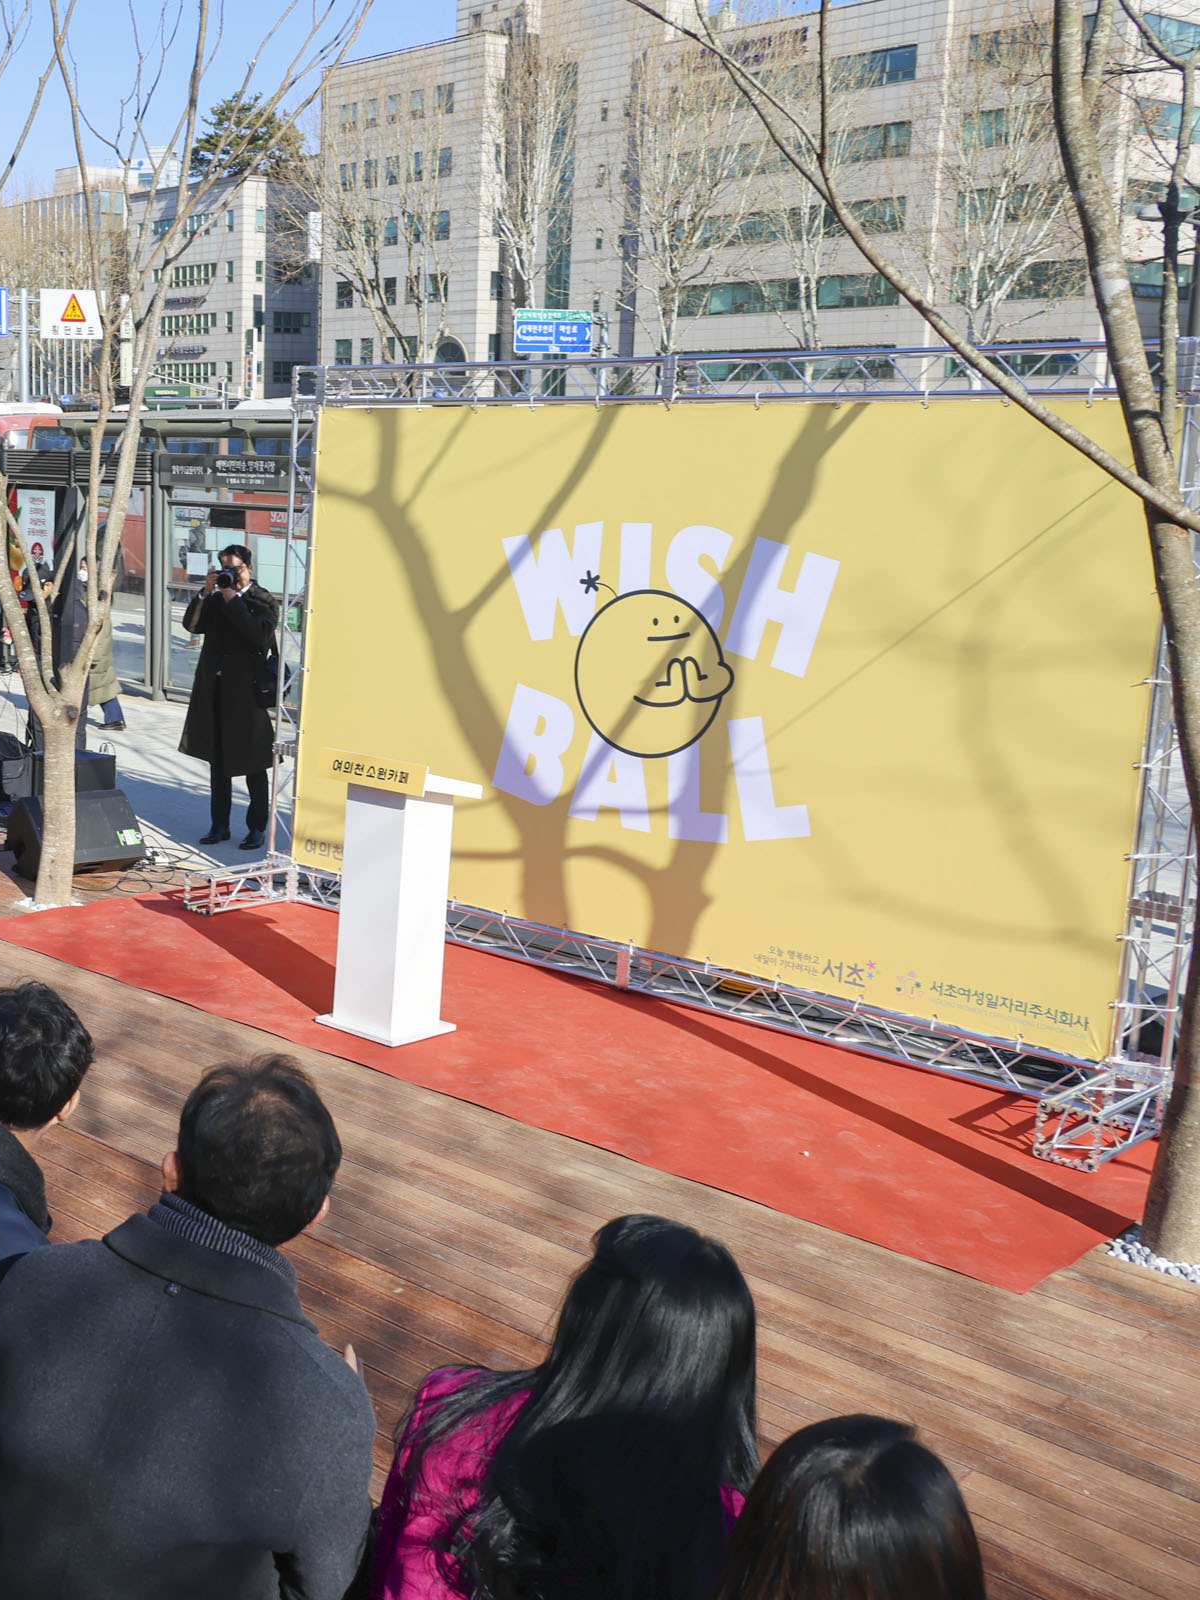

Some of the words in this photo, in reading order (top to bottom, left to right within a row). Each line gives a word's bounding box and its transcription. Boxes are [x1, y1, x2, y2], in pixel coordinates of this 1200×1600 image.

[501, 521, 840, 678] WISH
[332, 759, 365, 776] 여의천
[366, 765, 409, 784] 소원카페
[491, 682, 811, 844] BALL
[821, 958, 866, 988] 서초
[929, 980, 1091, 1032] 서초여성일자리주식회사
